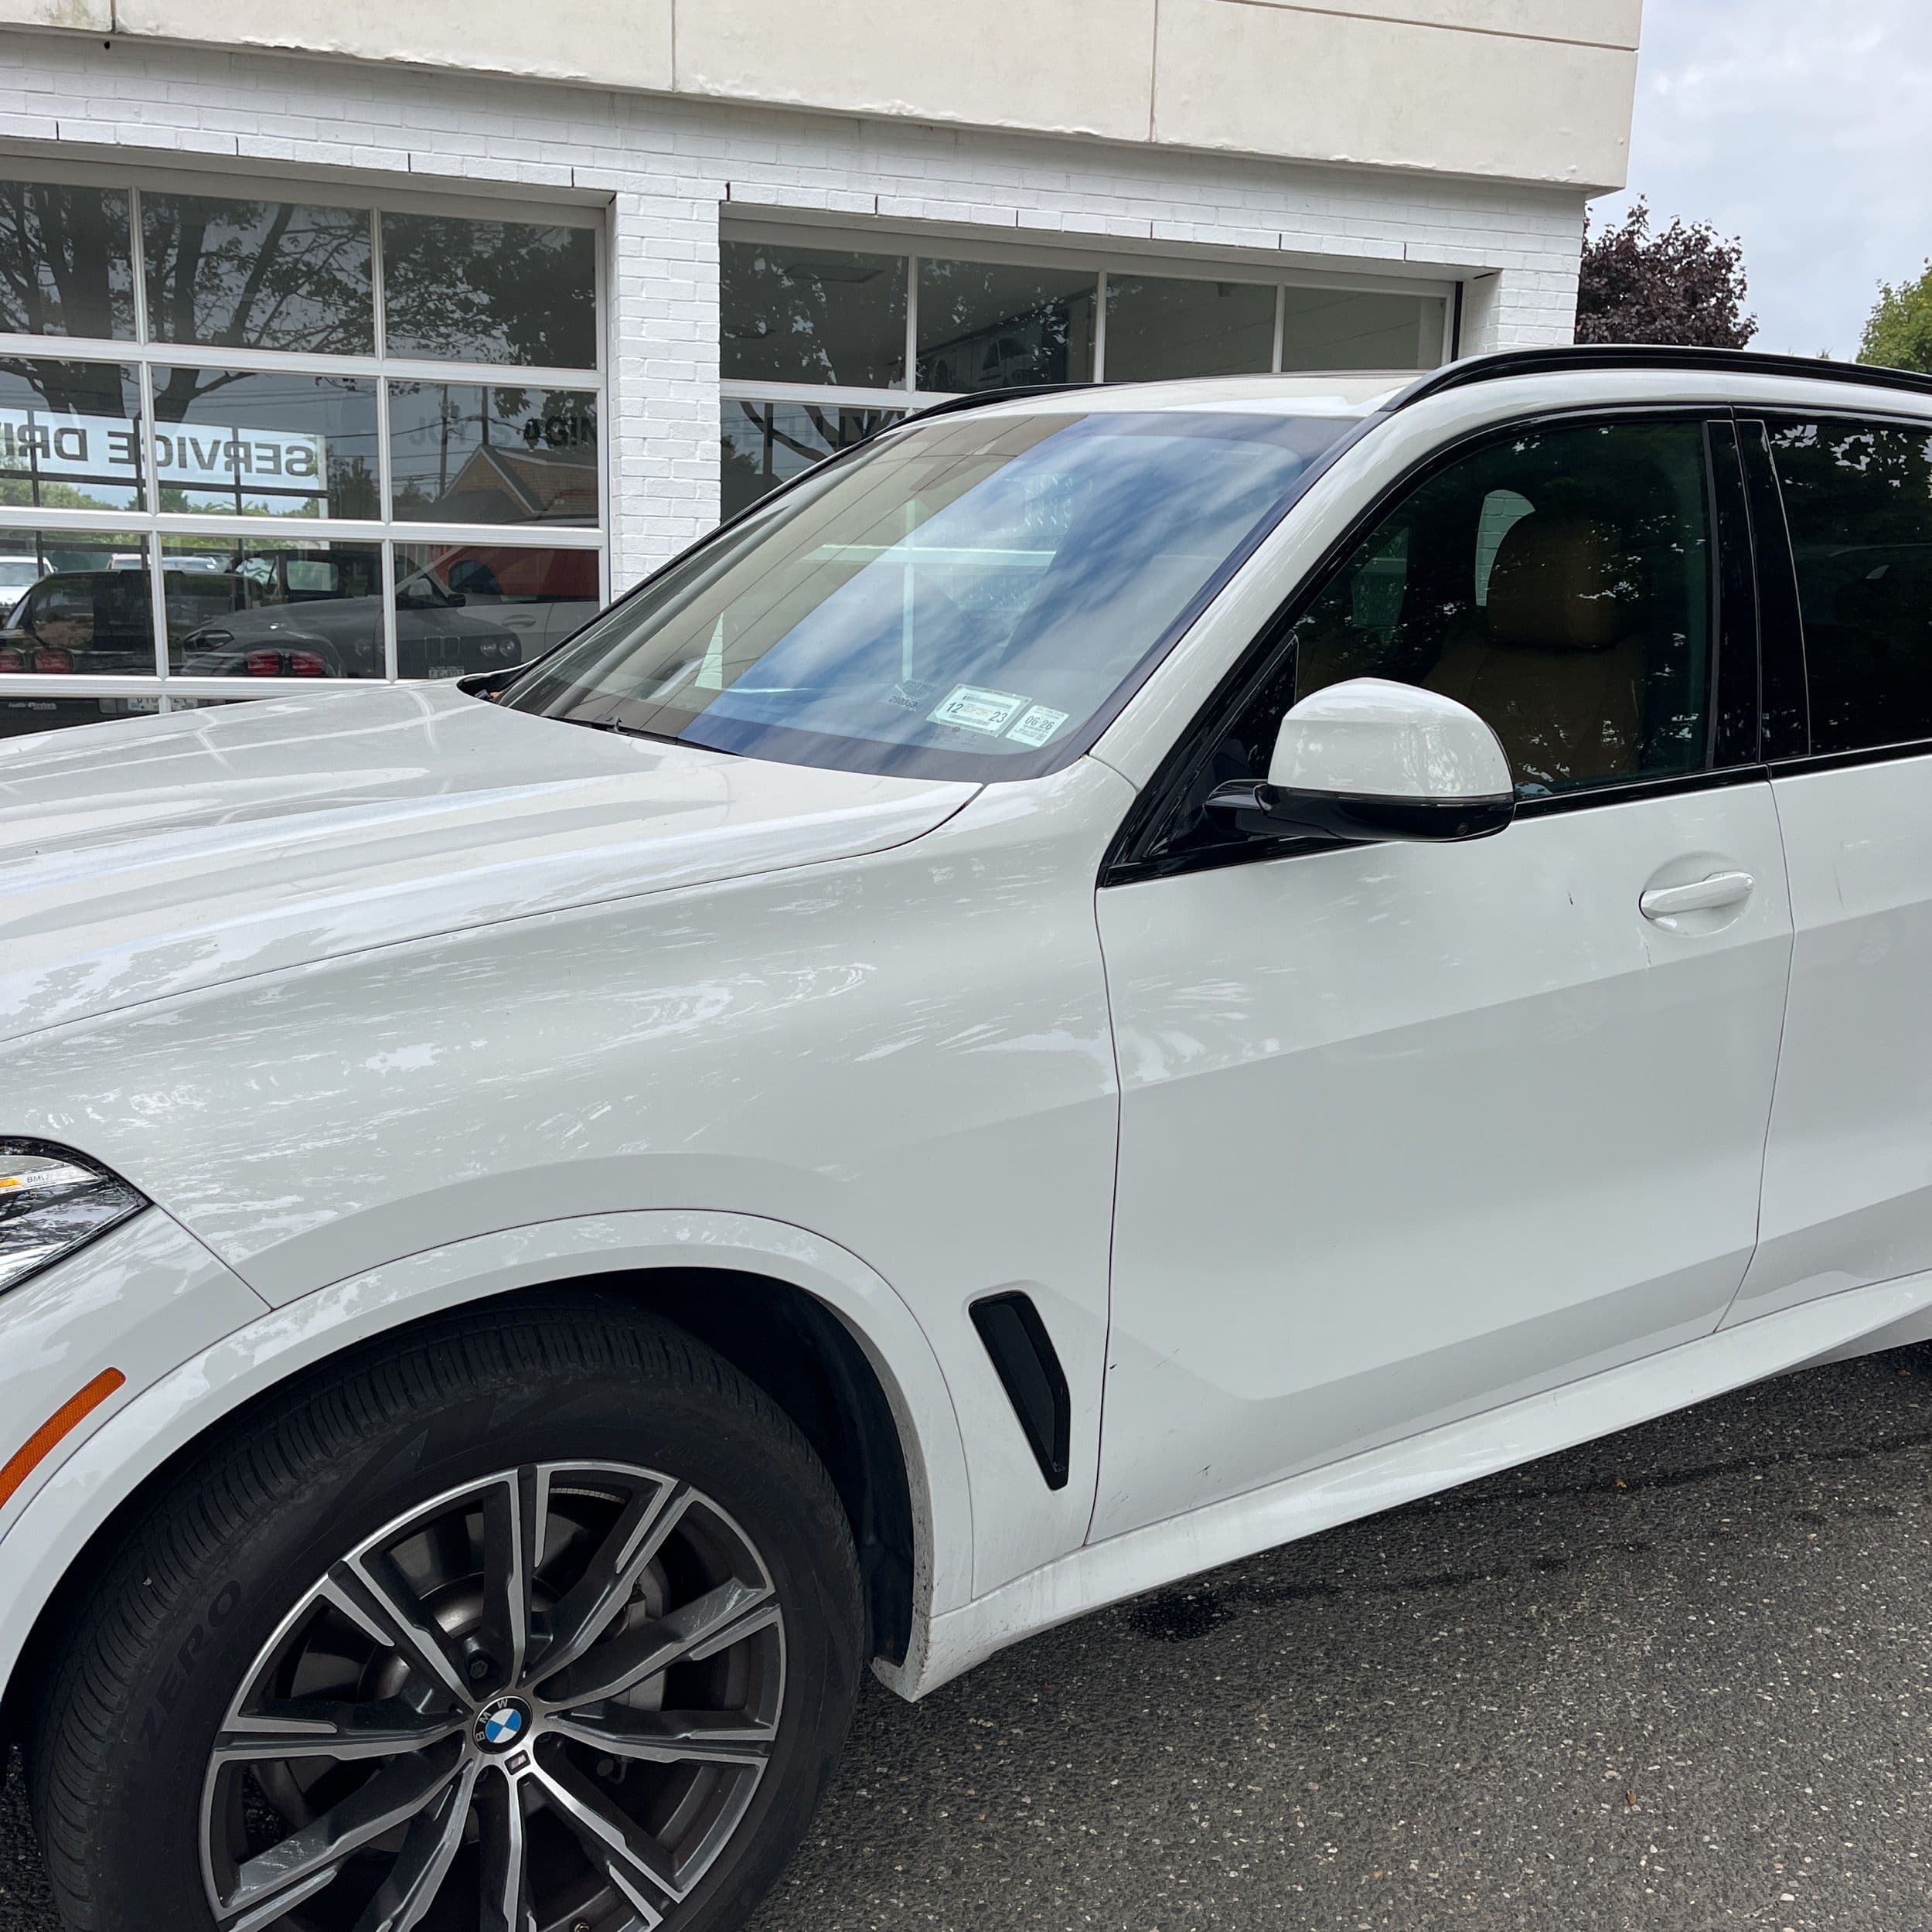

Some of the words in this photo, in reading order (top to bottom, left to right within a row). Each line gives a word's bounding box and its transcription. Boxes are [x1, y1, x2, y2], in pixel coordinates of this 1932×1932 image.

[946, 702, 964, 714] 12
[989, 711, 1008, 723] 23
[1025, 715, 1041, 726] 06
[1039, 720, 1055, 730] 26
[475, 1699, 508, 1742] BMW
